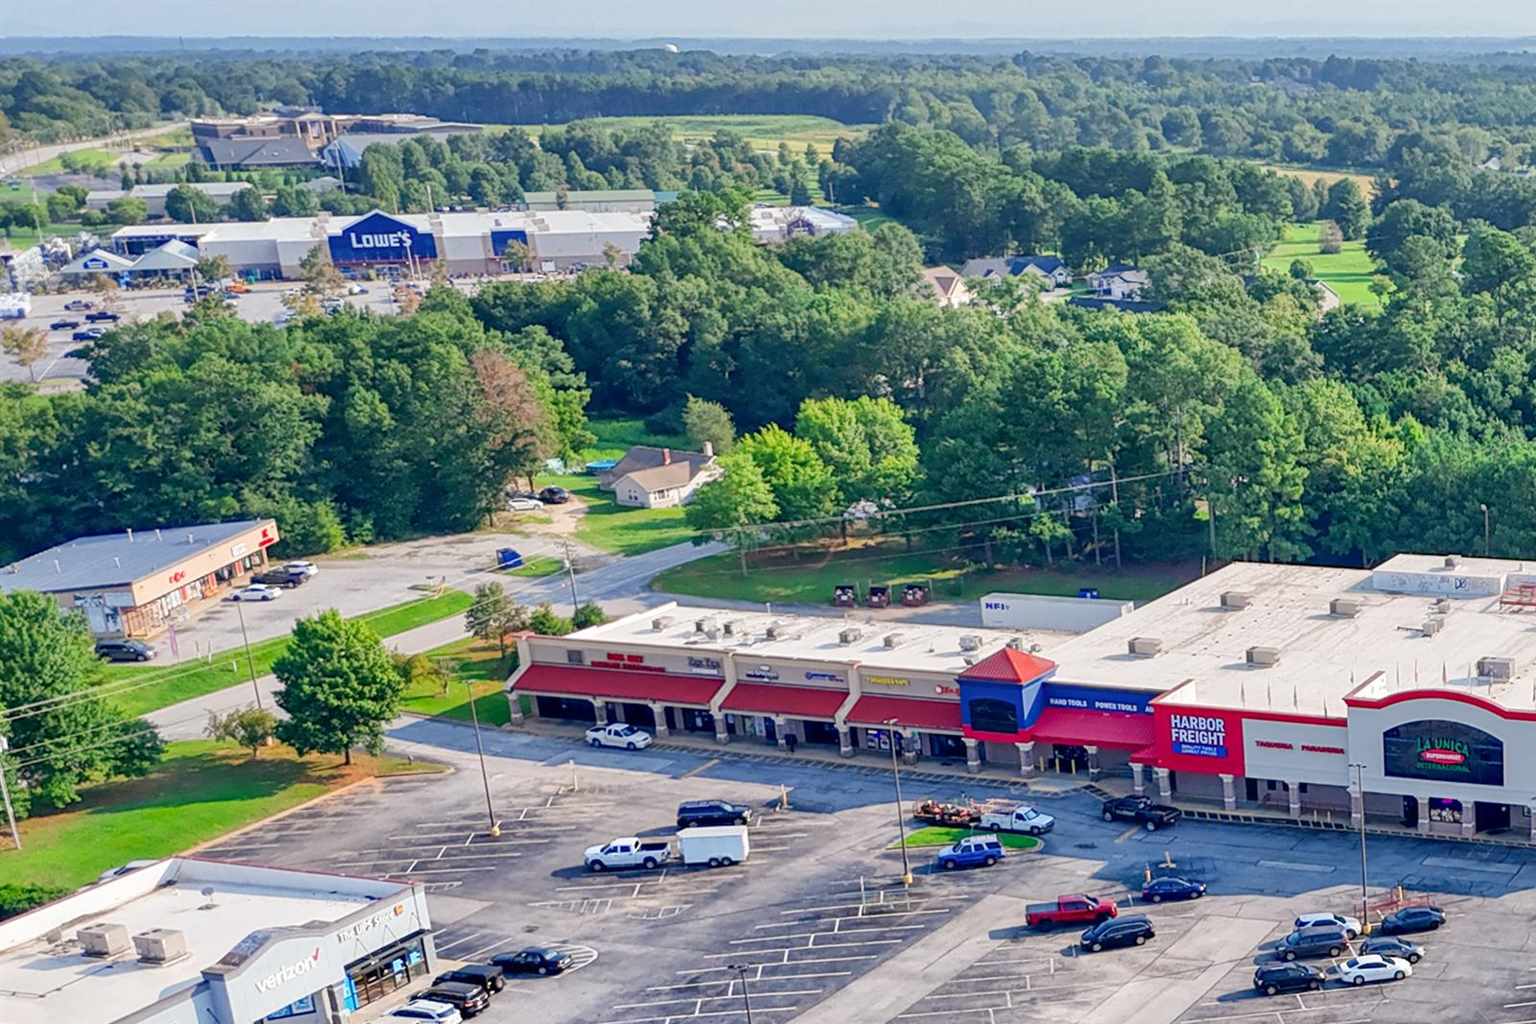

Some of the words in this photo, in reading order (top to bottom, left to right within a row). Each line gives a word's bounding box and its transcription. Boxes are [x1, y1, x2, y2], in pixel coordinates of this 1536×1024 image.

[350, 229, 412, 248] LOWE'S
[1068, 699, 1087, 708] TOOLS
[1095, 701, 1116, 711] POWER
[1117, 703, 1138, 712] TOOLS
[1170, 714, 1225, 732] HARBOR
[1171, 729, 1226, 746] FREIGHT
[1416, 737, 1430, 752] LA
[255, 957, 316, 993] verizon
